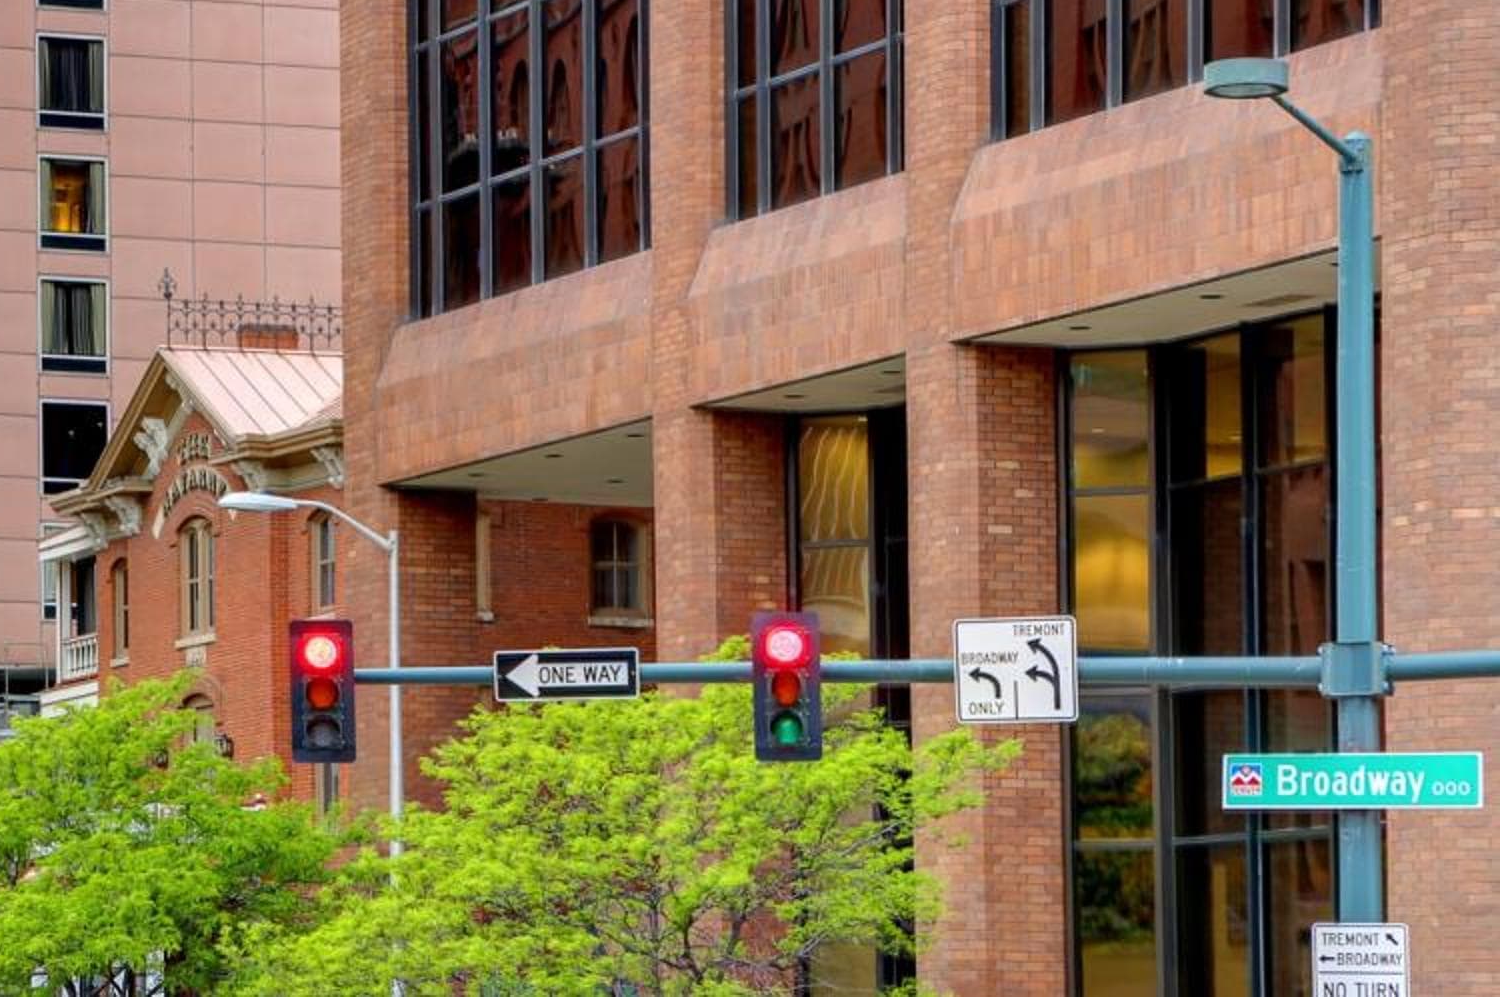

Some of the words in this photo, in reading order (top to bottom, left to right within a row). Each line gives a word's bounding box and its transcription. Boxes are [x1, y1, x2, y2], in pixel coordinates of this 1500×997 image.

[1012, 624, 1065, 636] TREMONT
[961, 652, 1019, 664] BROADWAY
[538, 666, 576, 684] ONE
[583, 664, 621, 682] WAY
[968, 702, 1004, 716] ONLY
[1276, 764, 1425, 803] Broadway
[1322, 932, 1380, 946] TREMONT
[1337, 952, 1403, 966] BROADWAY
[1323, 982, 1347, 997] NO
[1354, 982, 1400, 997] TURN
